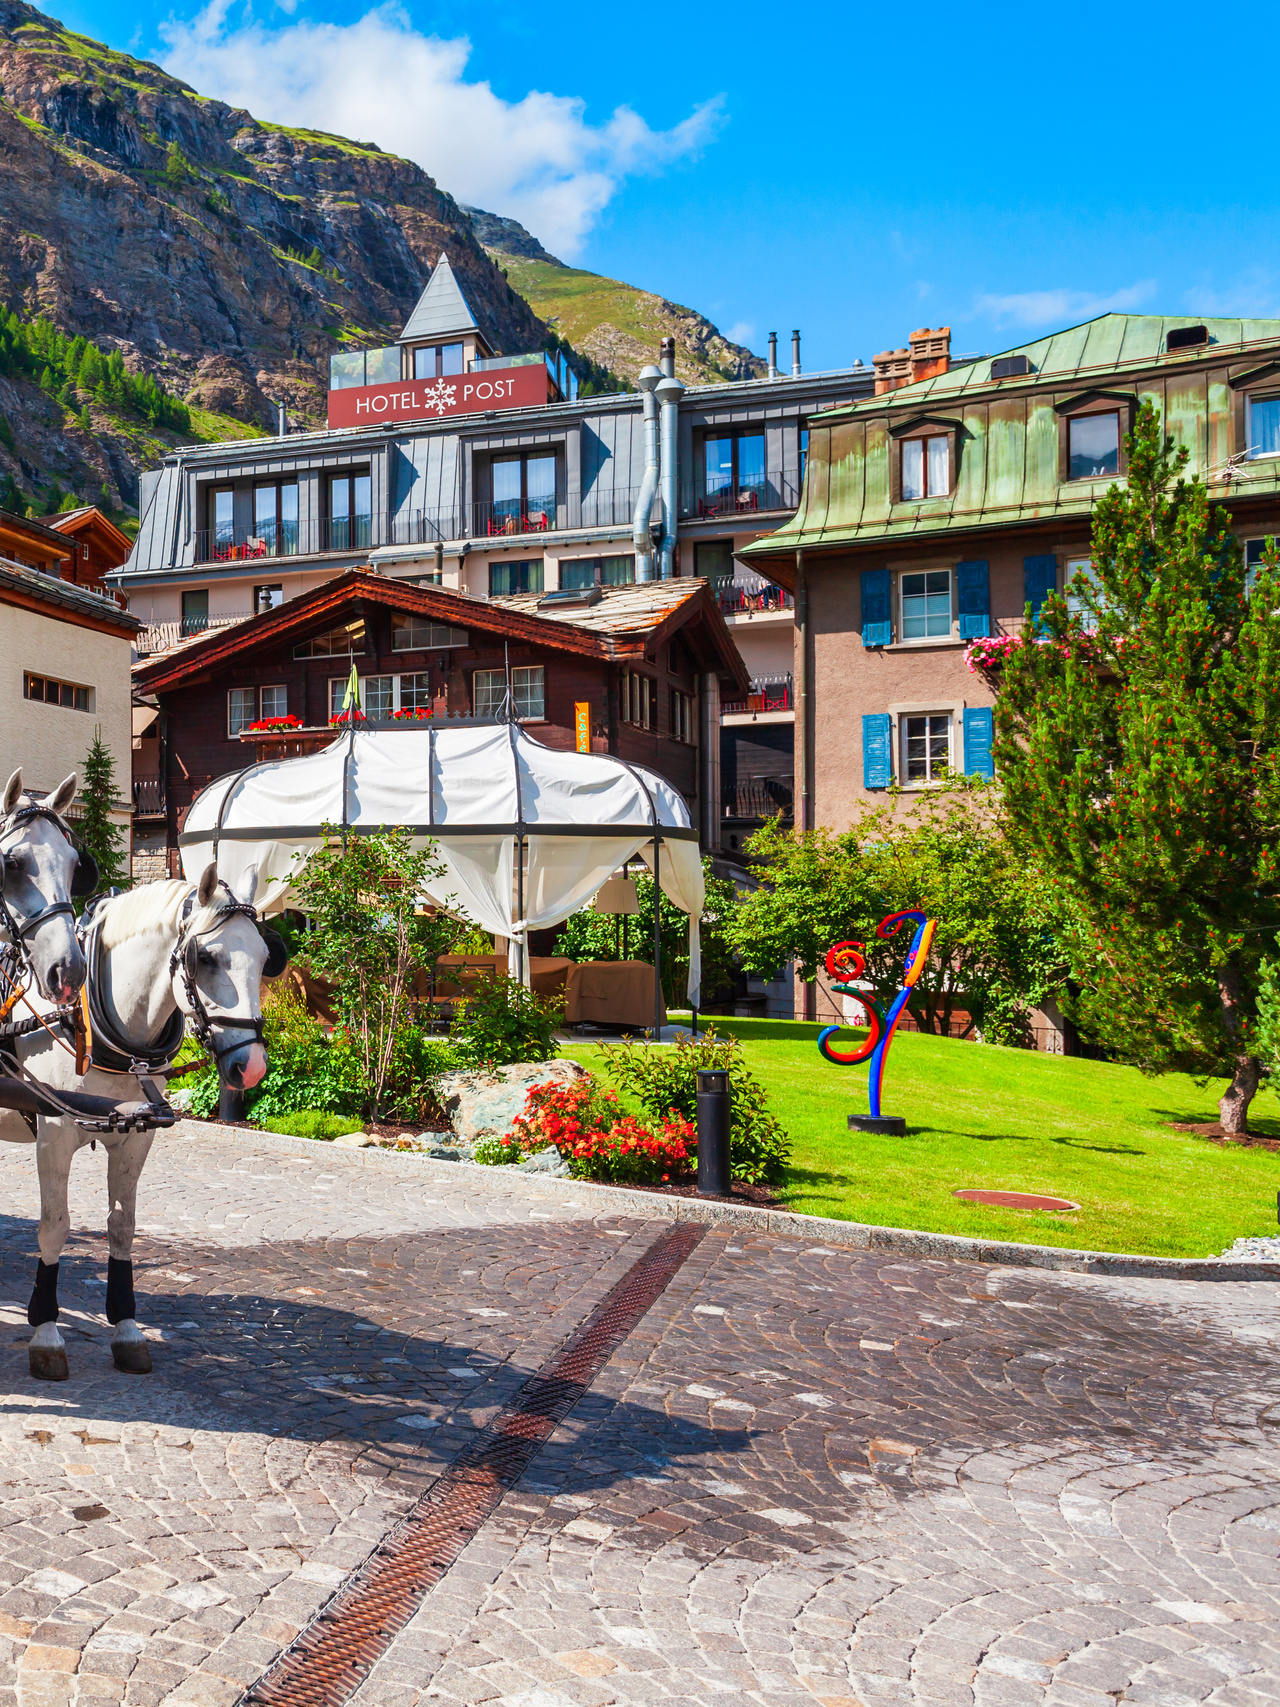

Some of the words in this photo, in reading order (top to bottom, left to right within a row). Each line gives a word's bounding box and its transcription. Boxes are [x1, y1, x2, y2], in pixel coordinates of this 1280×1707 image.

[356, 391, 420, 414] HOTEL
[463, 379, 515, 401] POST
[578, 712, 587, 753] Café
